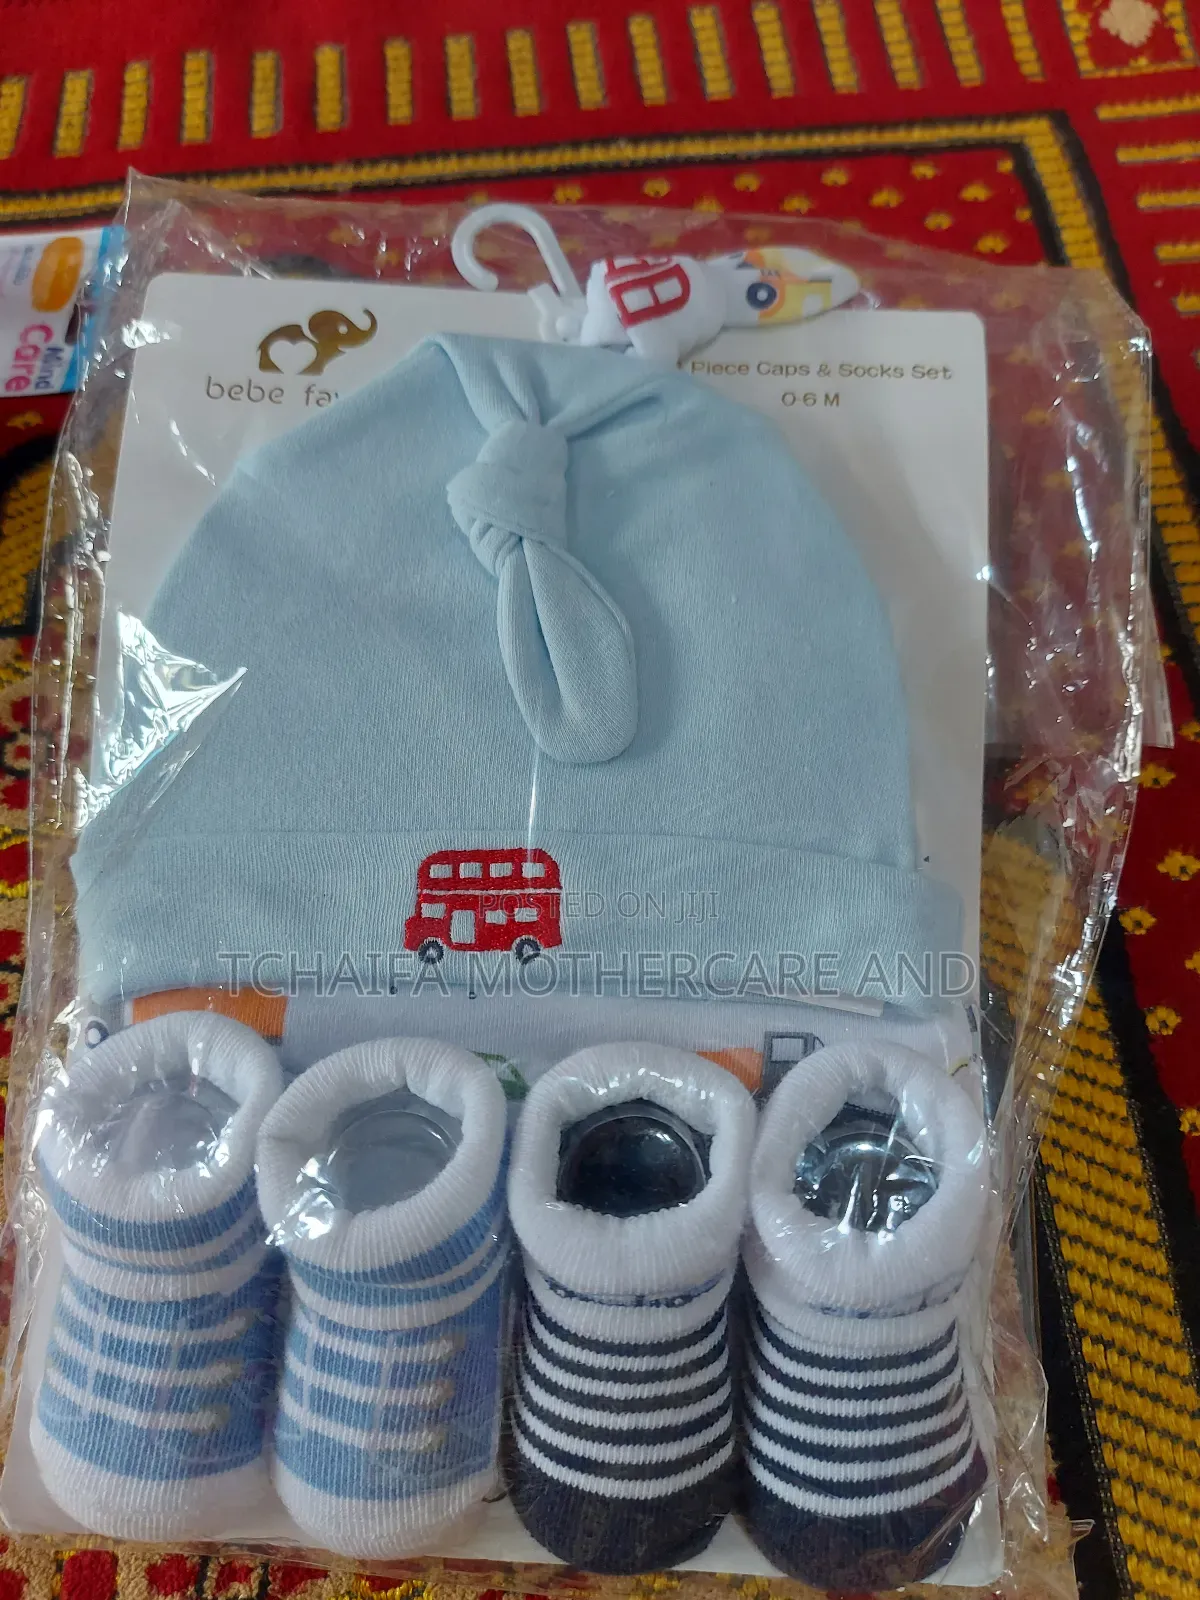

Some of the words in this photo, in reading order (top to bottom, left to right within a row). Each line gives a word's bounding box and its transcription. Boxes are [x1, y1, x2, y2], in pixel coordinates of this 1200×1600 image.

[5, 323, 54, 392] Care
[690, 360, 750, 376] Piece
[756, 361, 811, 378] Caps
[816, 363, 832, 378] &
[838, 362, 905, 379] Socks
[911, 364, 953, 380] Set
[206, 375, 285, 405] bebe
[304, 384, 339, 408] fa
[824, 391, 840, 407] M
